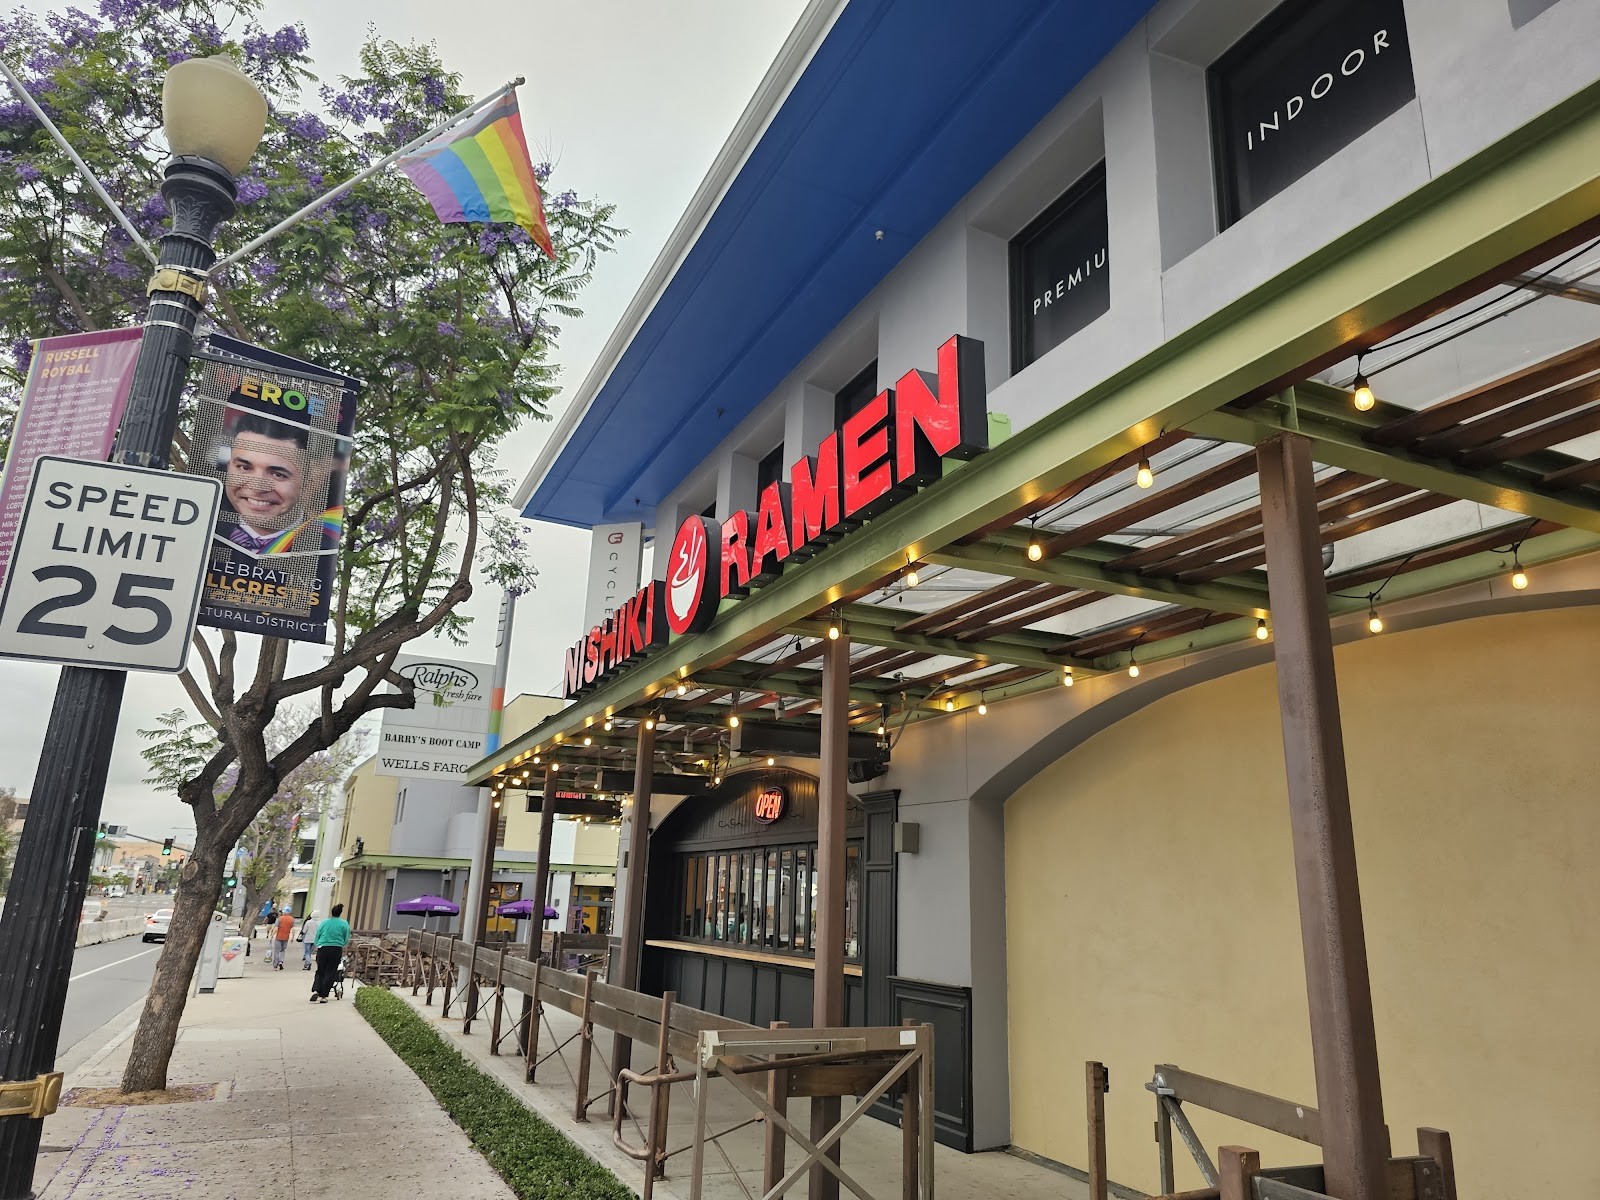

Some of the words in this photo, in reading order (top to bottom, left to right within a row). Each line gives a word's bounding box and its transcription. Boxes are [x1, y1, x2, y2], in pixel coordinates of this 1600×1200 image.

[1246, 29, 1390, 150] INDOOR
[1032, 248, 1106, 315] PREMIU
[45, 348, 99, 364] RUSSELL
[41, 364, 91, 378] ROYBAL
[37, 444, 60, 453] National
[45, 482, 200, 526] SPEED
[562, 580, 655, 700] NISHIKI
[720, 334, 961, 600] RAMEN
[52, 522, 176, 562] LIMIT
[211, 559, 322, 591] LEBRATING
[206, 573, 320, 606] LLCREST'S
[16, 565, 174, 646] 25
[199, 606, 250, 623] LTURAL
[256, 615, 316, 632] DISTRICT
[412, 666, 468, 688] Ralphs
[463, 691, 482, 702] fare
[384, 733, 427, 745] BARRY'S
[429, 737, 454, 747] BOOT
[456, 740, 481, 750] CAMP
[382, 758, 430, 770] WELLS
[756, 794, 781, 819] OPEN
